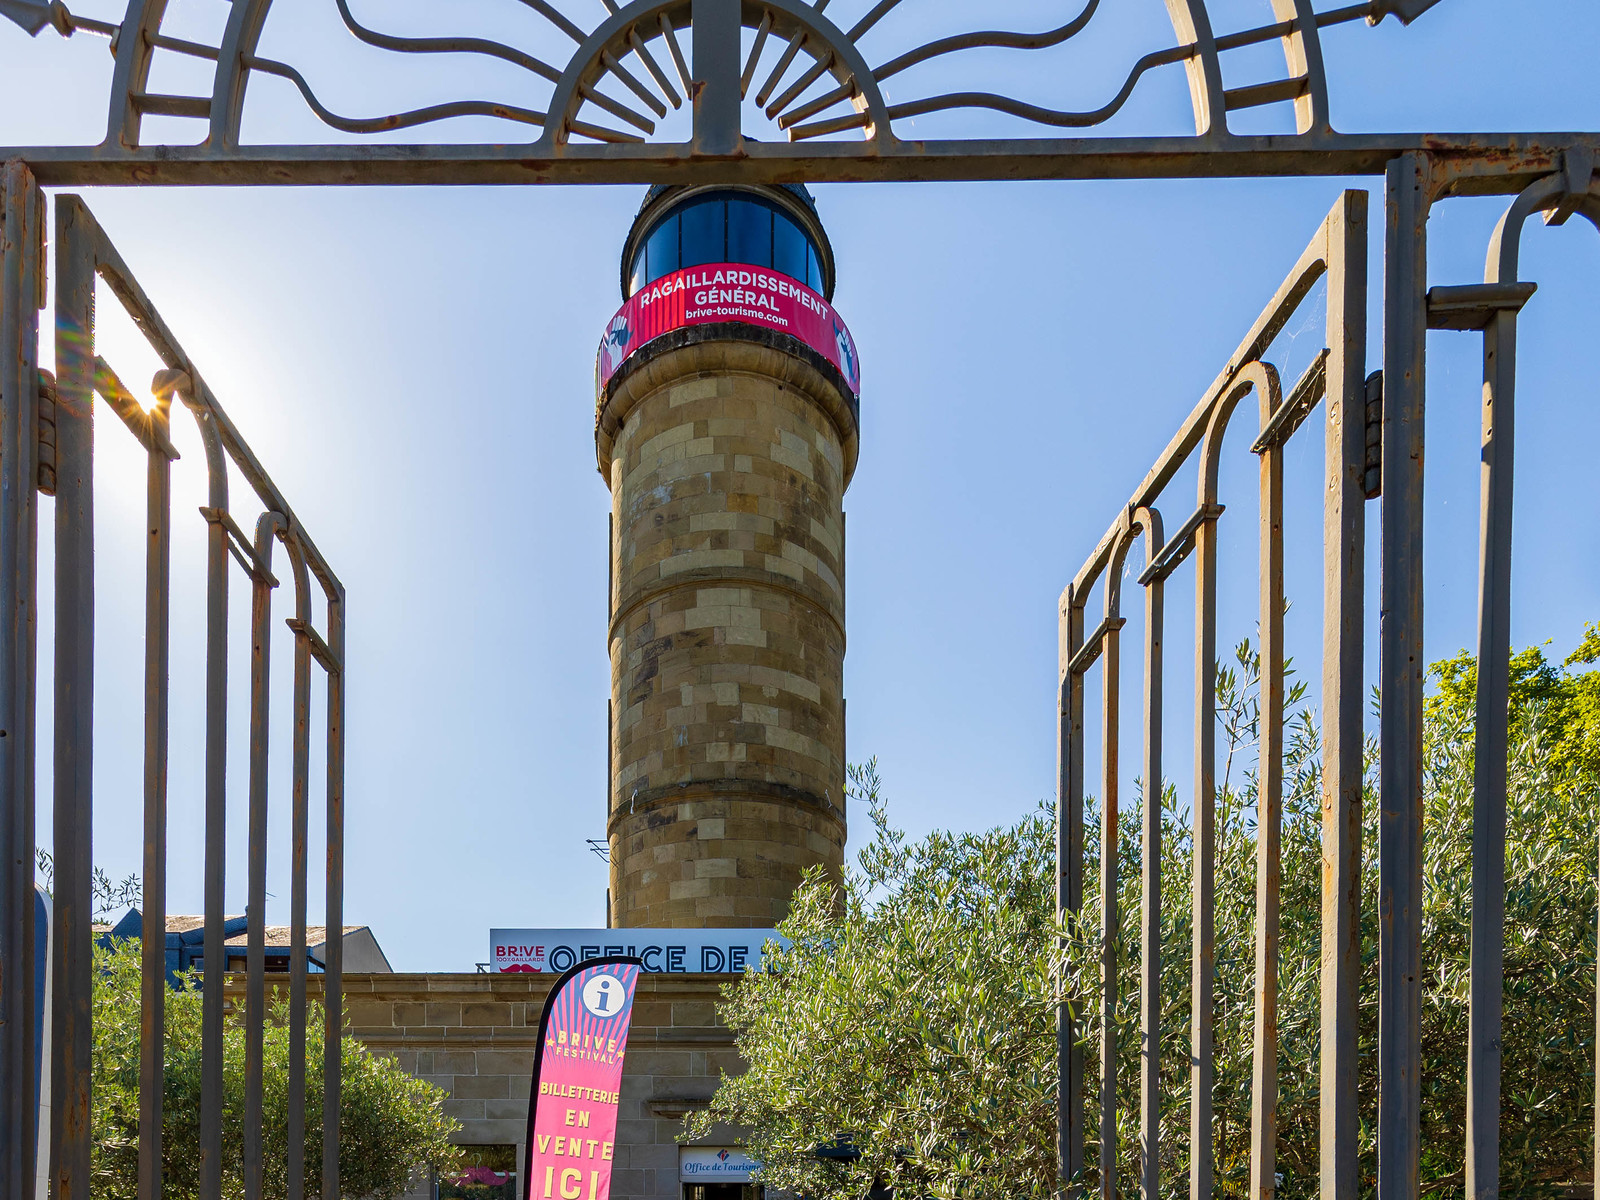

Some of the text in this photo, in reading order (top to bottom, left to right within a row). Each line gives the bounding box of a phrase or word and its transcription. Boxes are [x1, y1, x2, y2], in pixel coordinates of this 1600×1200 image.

[640, 271, 828, 320] RAGAILLARDISSEMENT
[694, 287, 780, 311] GÉNÉRAL
[685, 306, 788, 326] brive-tourisme.com
[701, 945, 749, 973] DE
[557, 1030, 617, 1053] BRIVE
[555, 1046, 615, 1065] FESTIVAL
[540, 1081, 620, 1104] BILLETTERIE
[565, 1109, 591, 1128] EN
[537, 1134, 614, 1161] VENTE
[684, 1162, 710, 1173] Office
[711, 1163, 721, 1171] de
